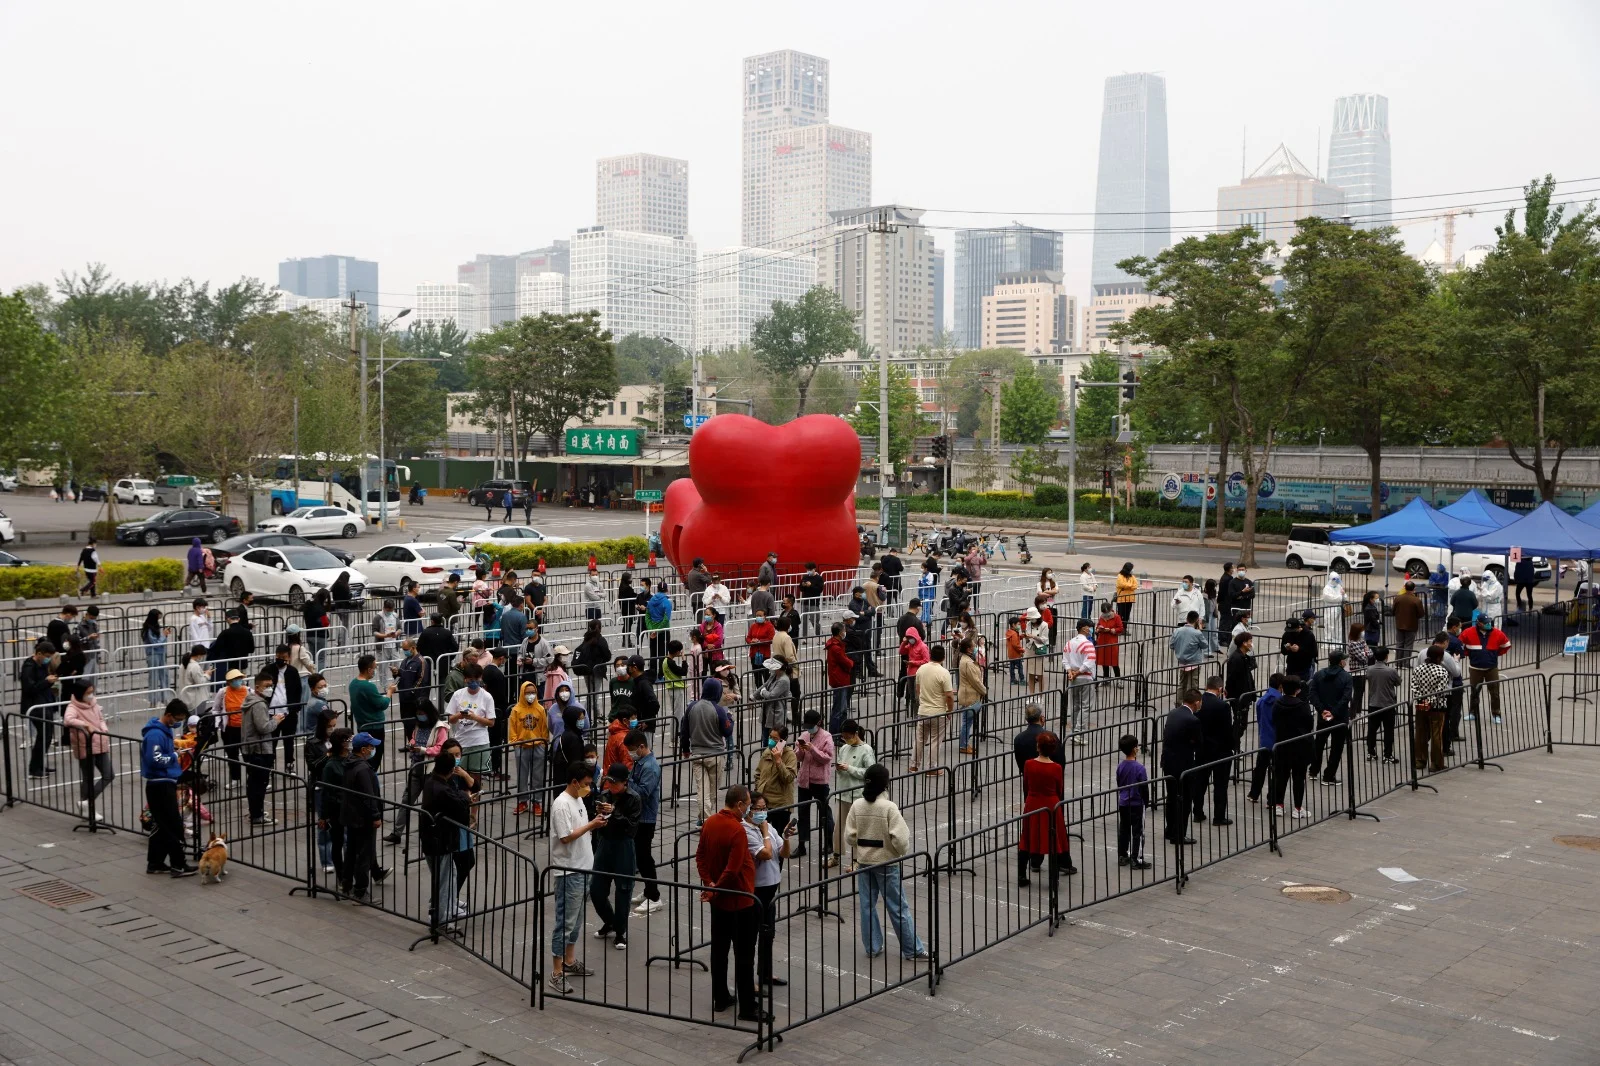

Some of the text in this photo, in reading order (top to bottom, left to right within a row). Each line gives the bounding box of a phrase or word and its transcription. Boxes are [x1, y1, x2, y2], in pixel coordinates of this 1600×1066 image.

[571, 433, 629, 450] 日盛牛肉面
